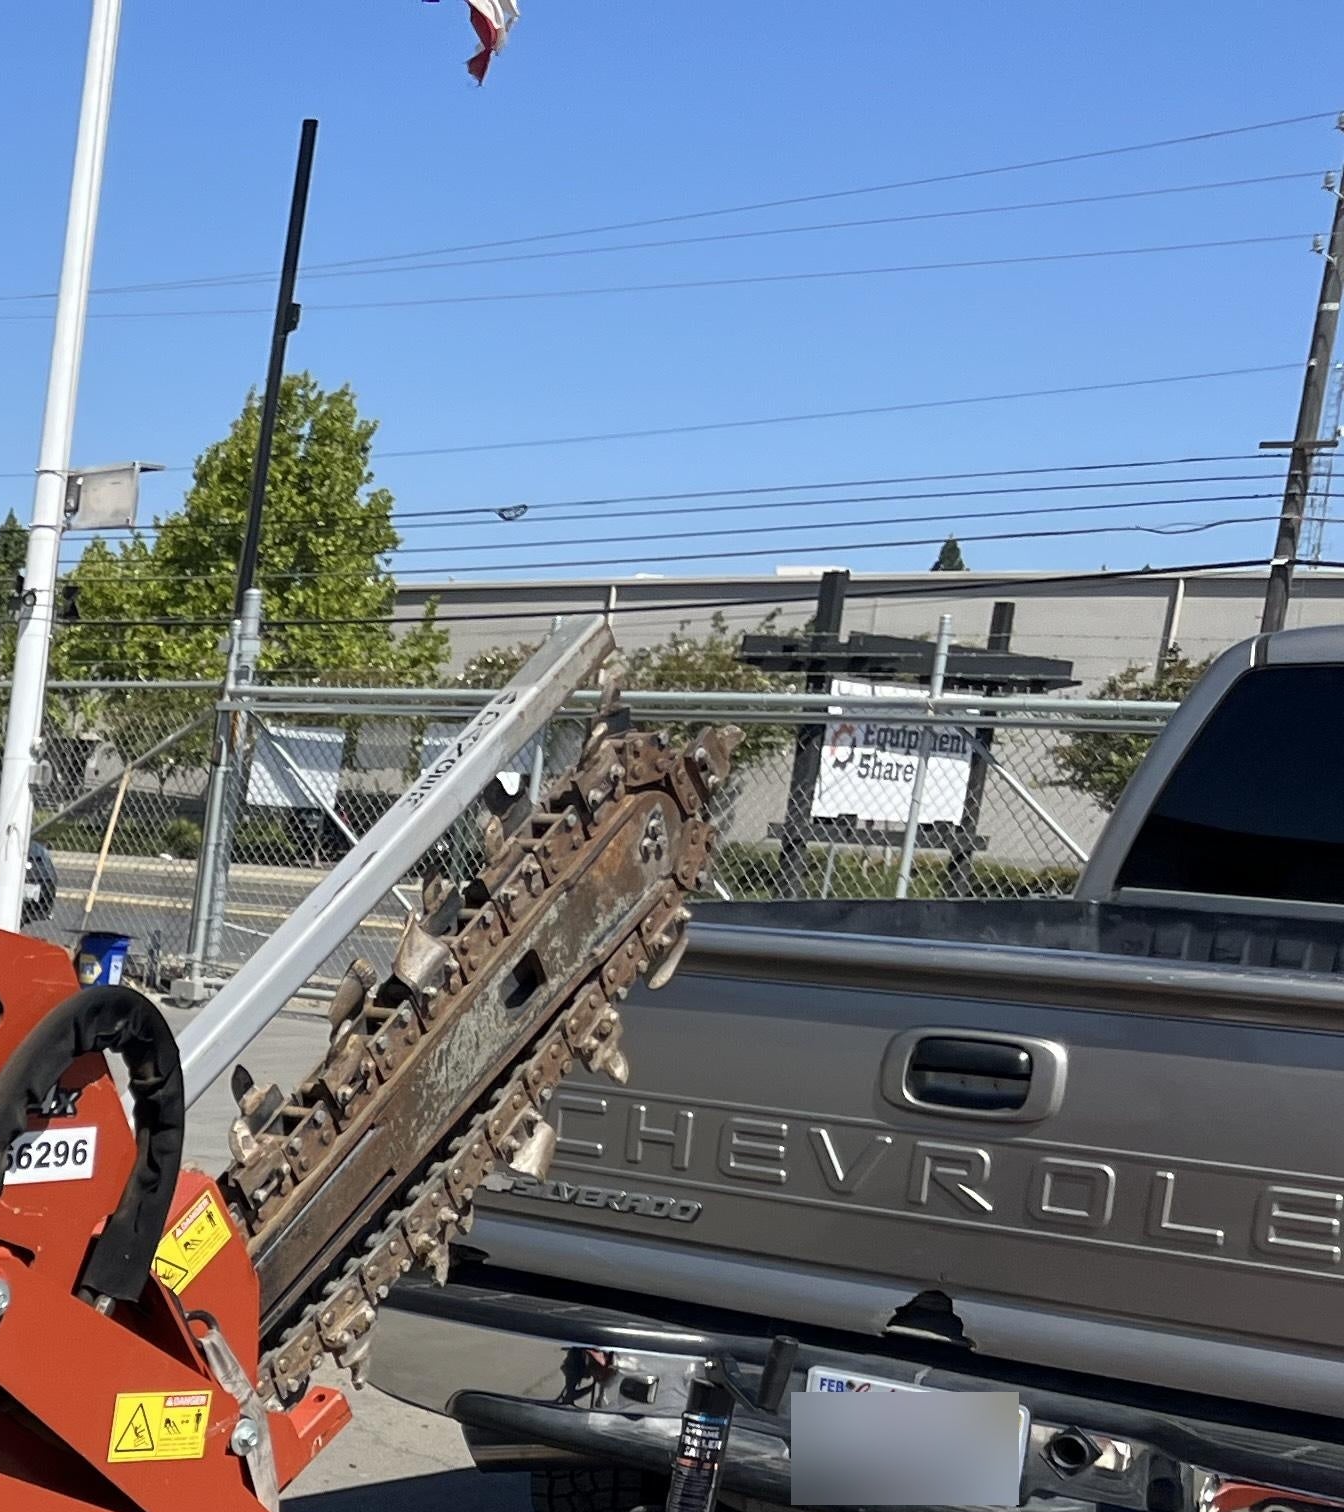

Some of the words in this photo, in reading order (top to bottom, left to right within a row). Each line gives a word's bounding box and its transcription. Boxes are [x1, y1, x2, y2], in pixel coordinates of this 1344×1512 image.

[863, 723, 968, 756] Equipent
[857, 751, 915, 783] Share
[820, 1378, 844, 1392] FEB
